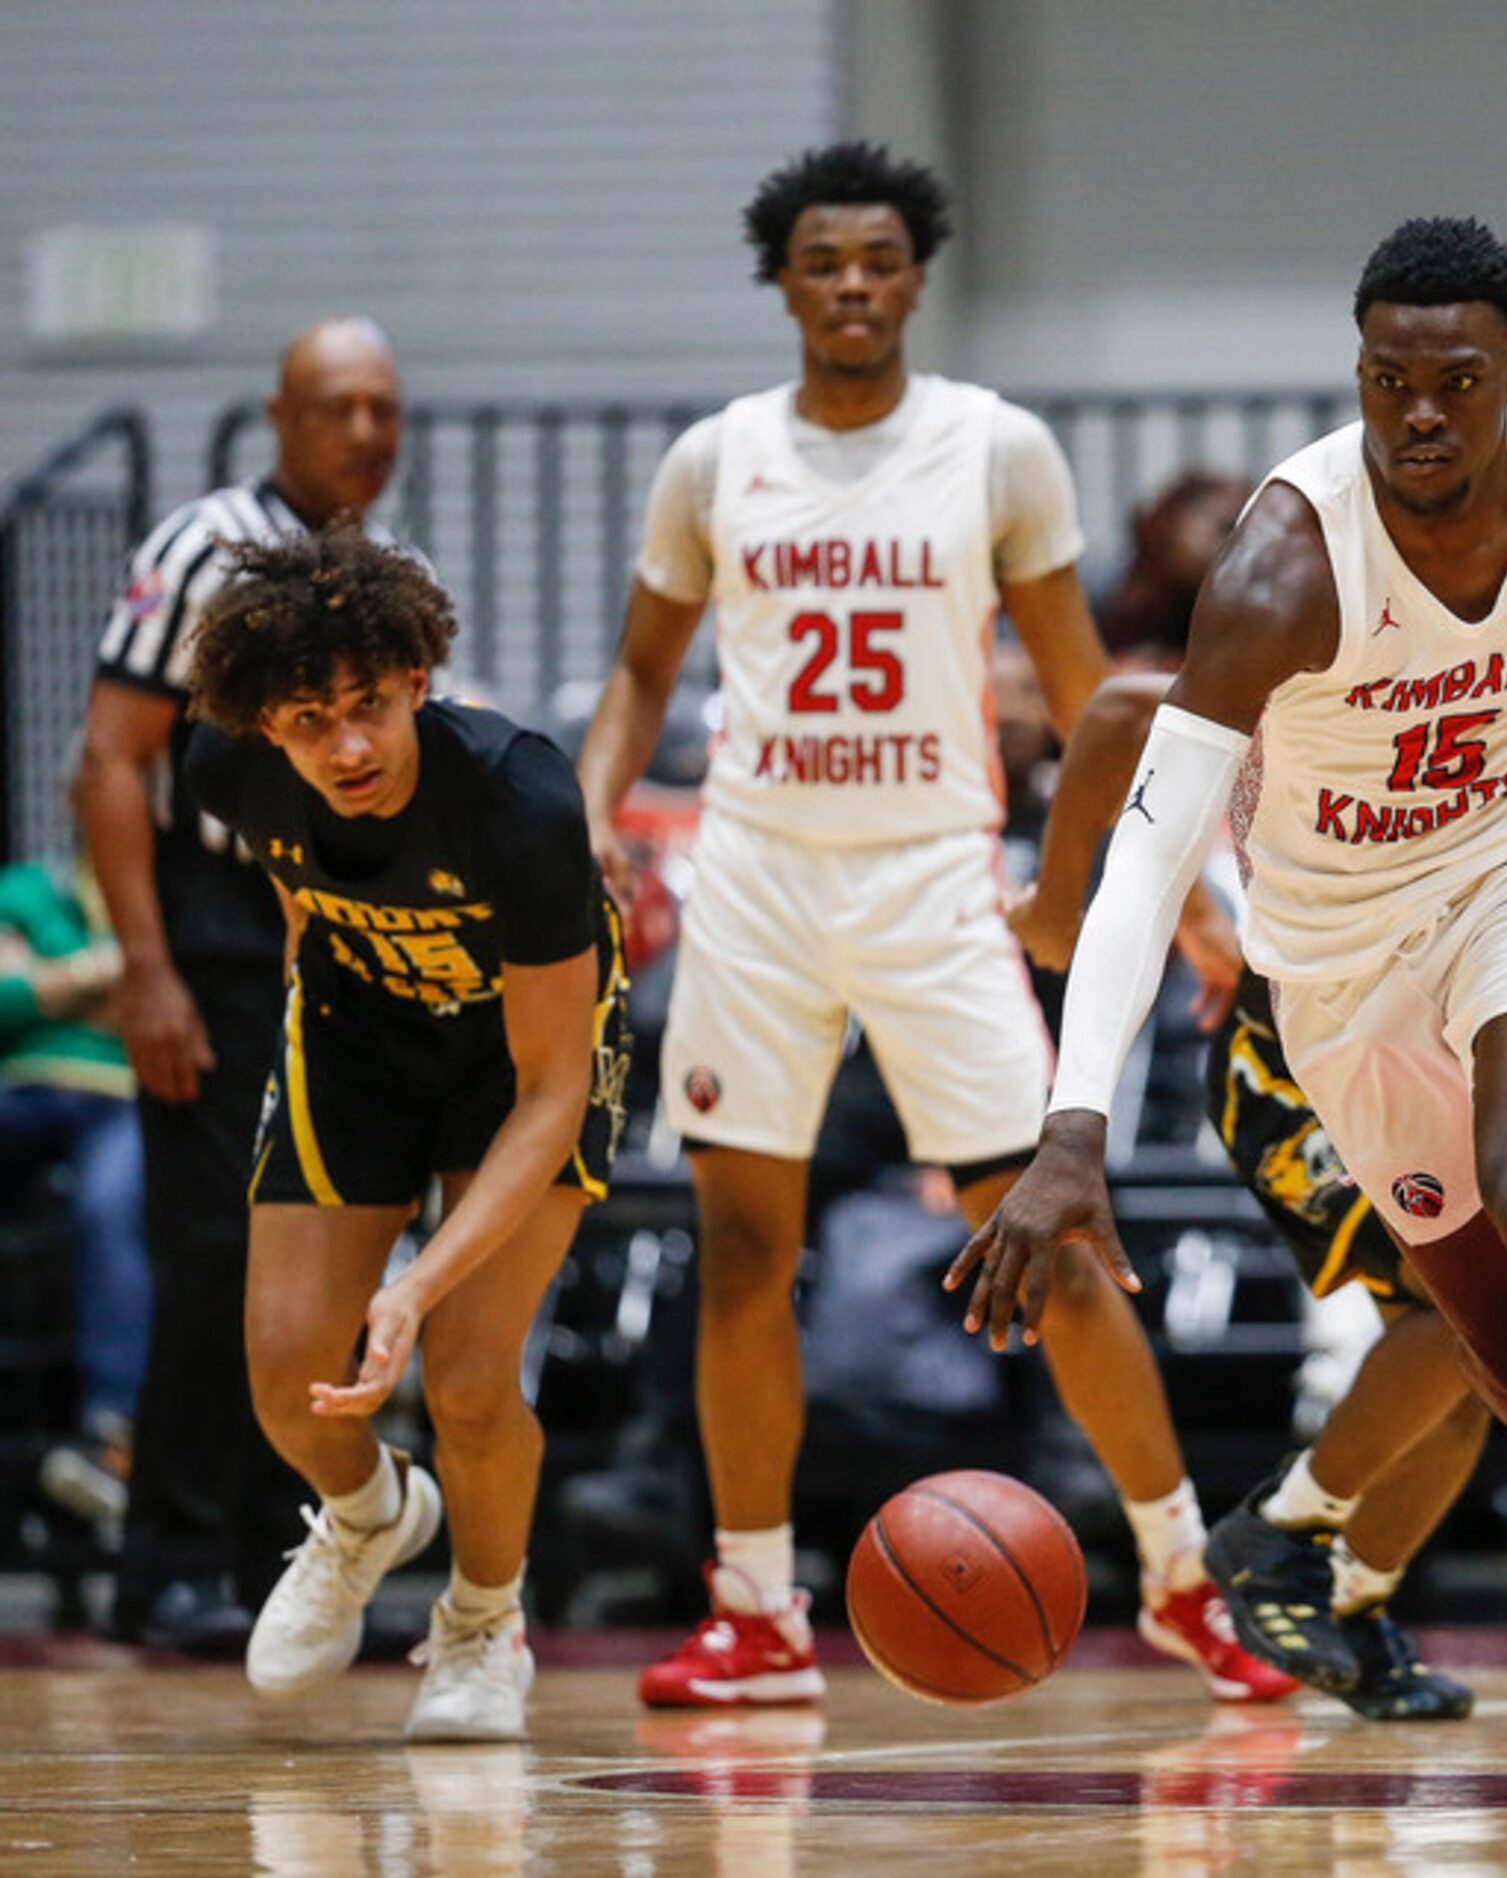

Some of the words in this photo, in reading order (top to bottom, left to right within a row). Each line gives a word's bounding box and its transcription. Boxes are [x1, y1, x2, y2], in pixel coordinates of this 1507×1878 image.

[742, 539, 945, 590] KIMBALL
[788, 610, 905, 713] 25
[755, 733, 942, 785] KNIGHTS
[1386, 708, 1503, 792] 15
